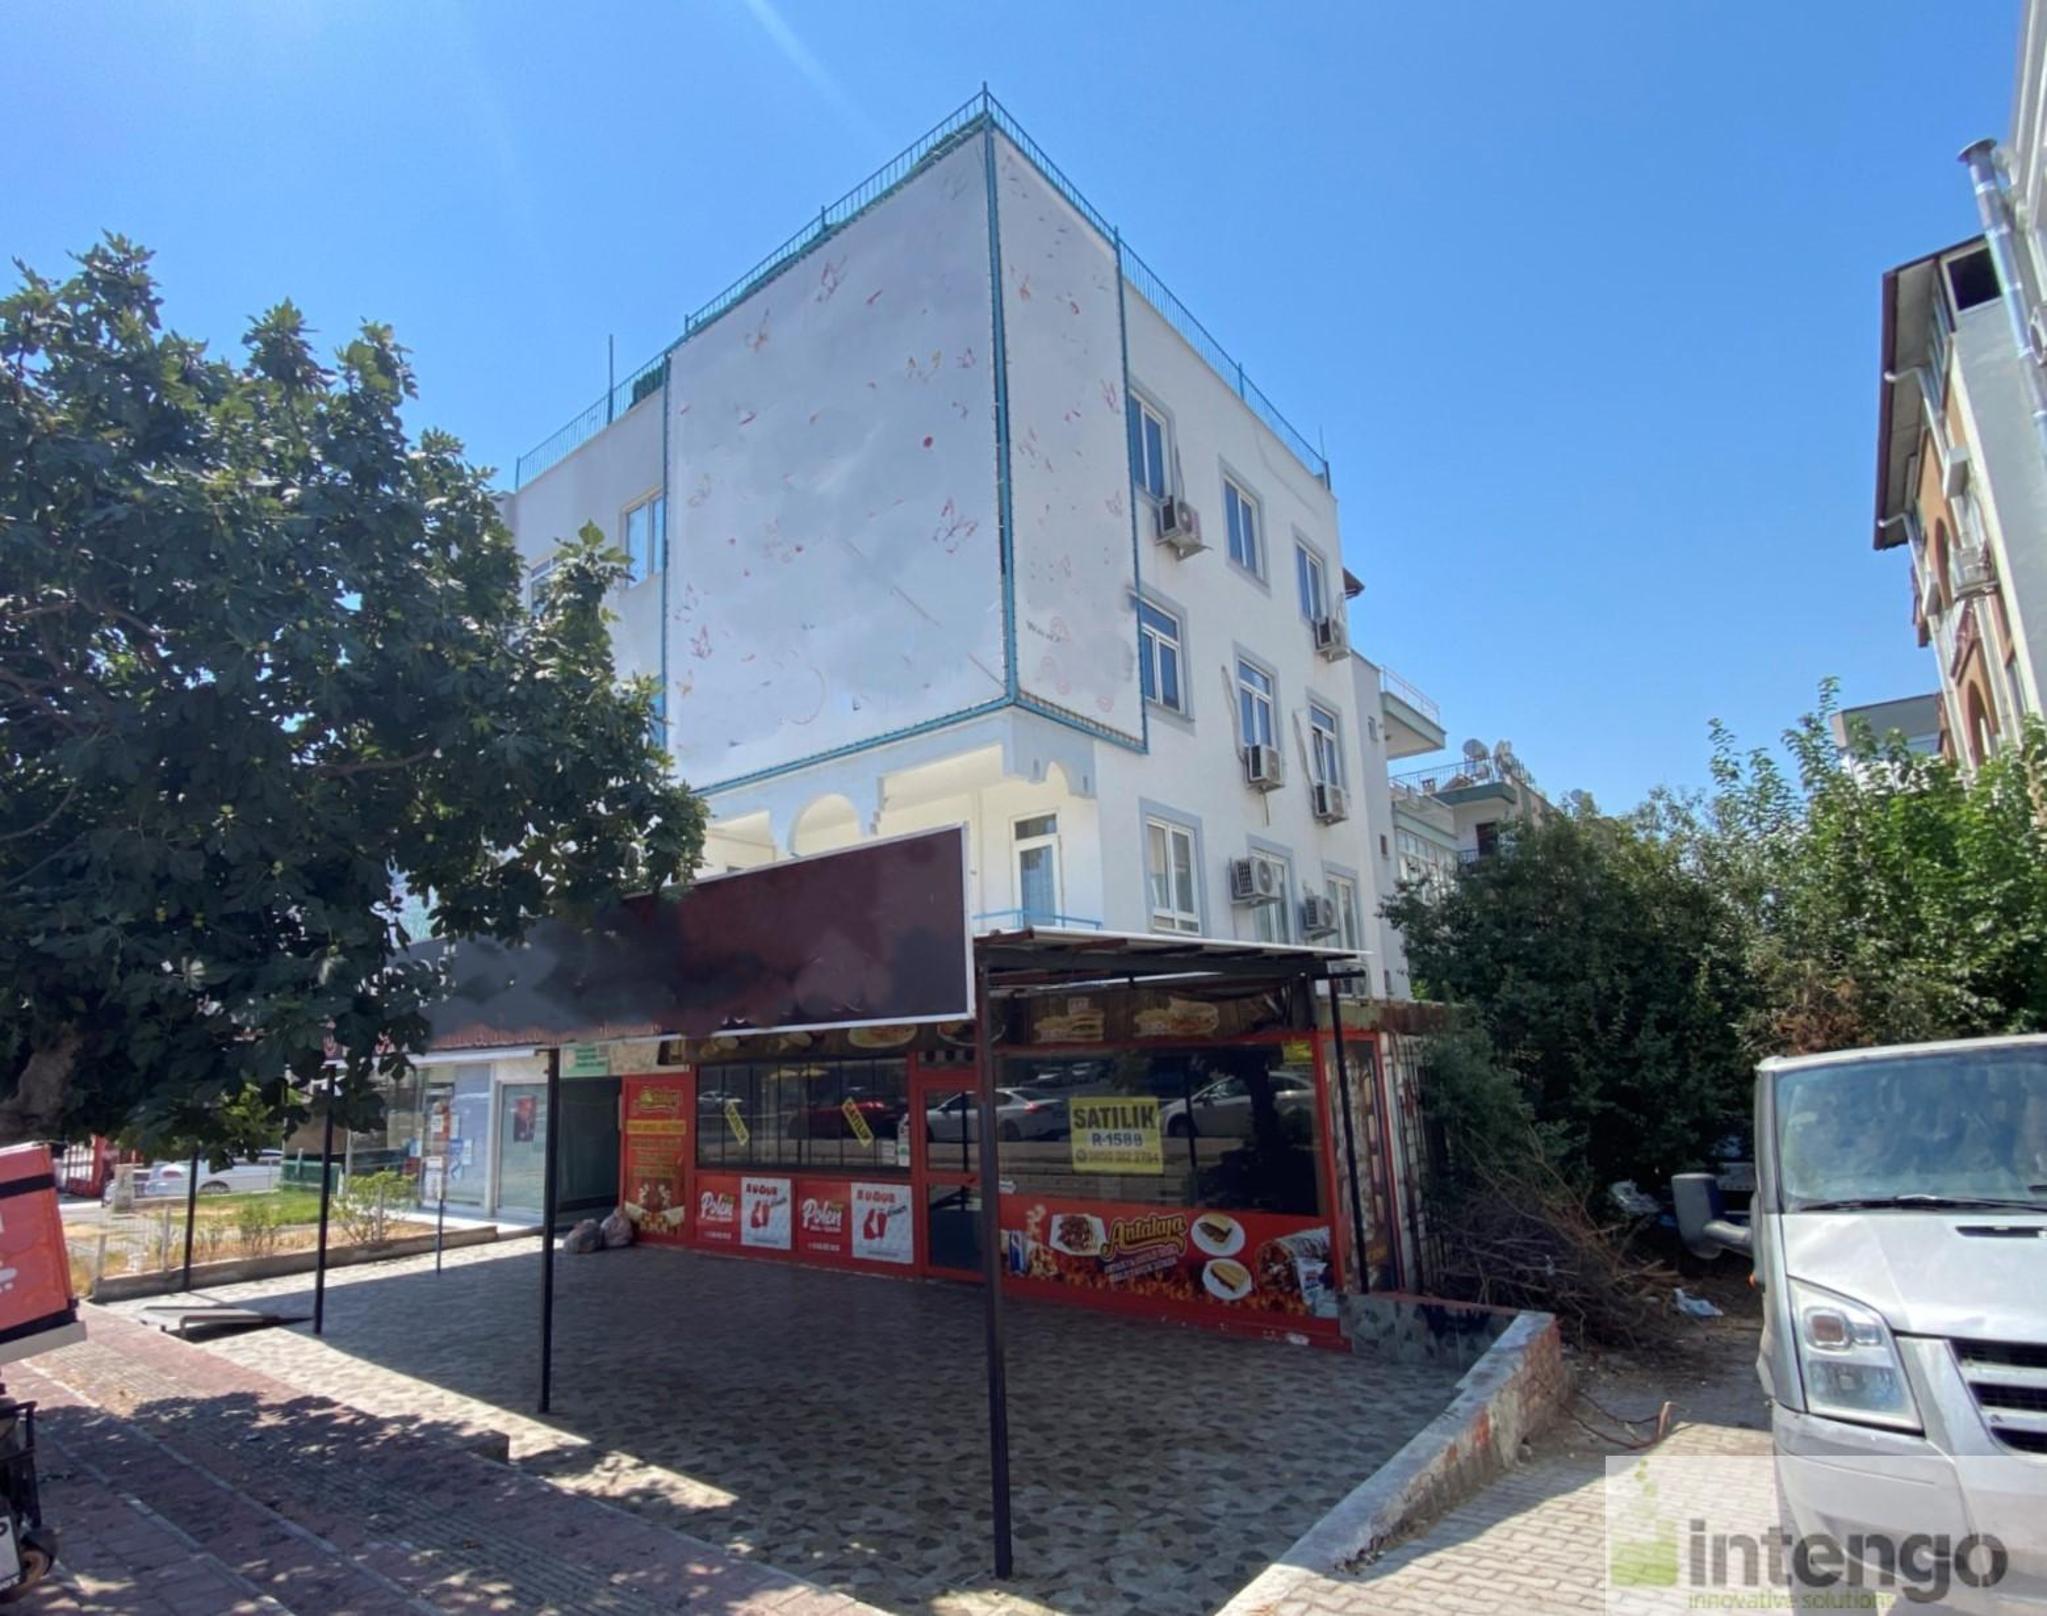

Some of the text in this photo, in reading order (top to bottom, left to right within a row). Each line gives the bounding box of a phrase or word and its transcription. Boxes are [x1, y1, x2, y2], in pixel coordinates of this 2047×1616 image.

[1073, 1105, 1156, 1130] SATILIK
[802, 1198, 843, 1229] Polen
[1101, 1214, 1186, 1259] Antalya
